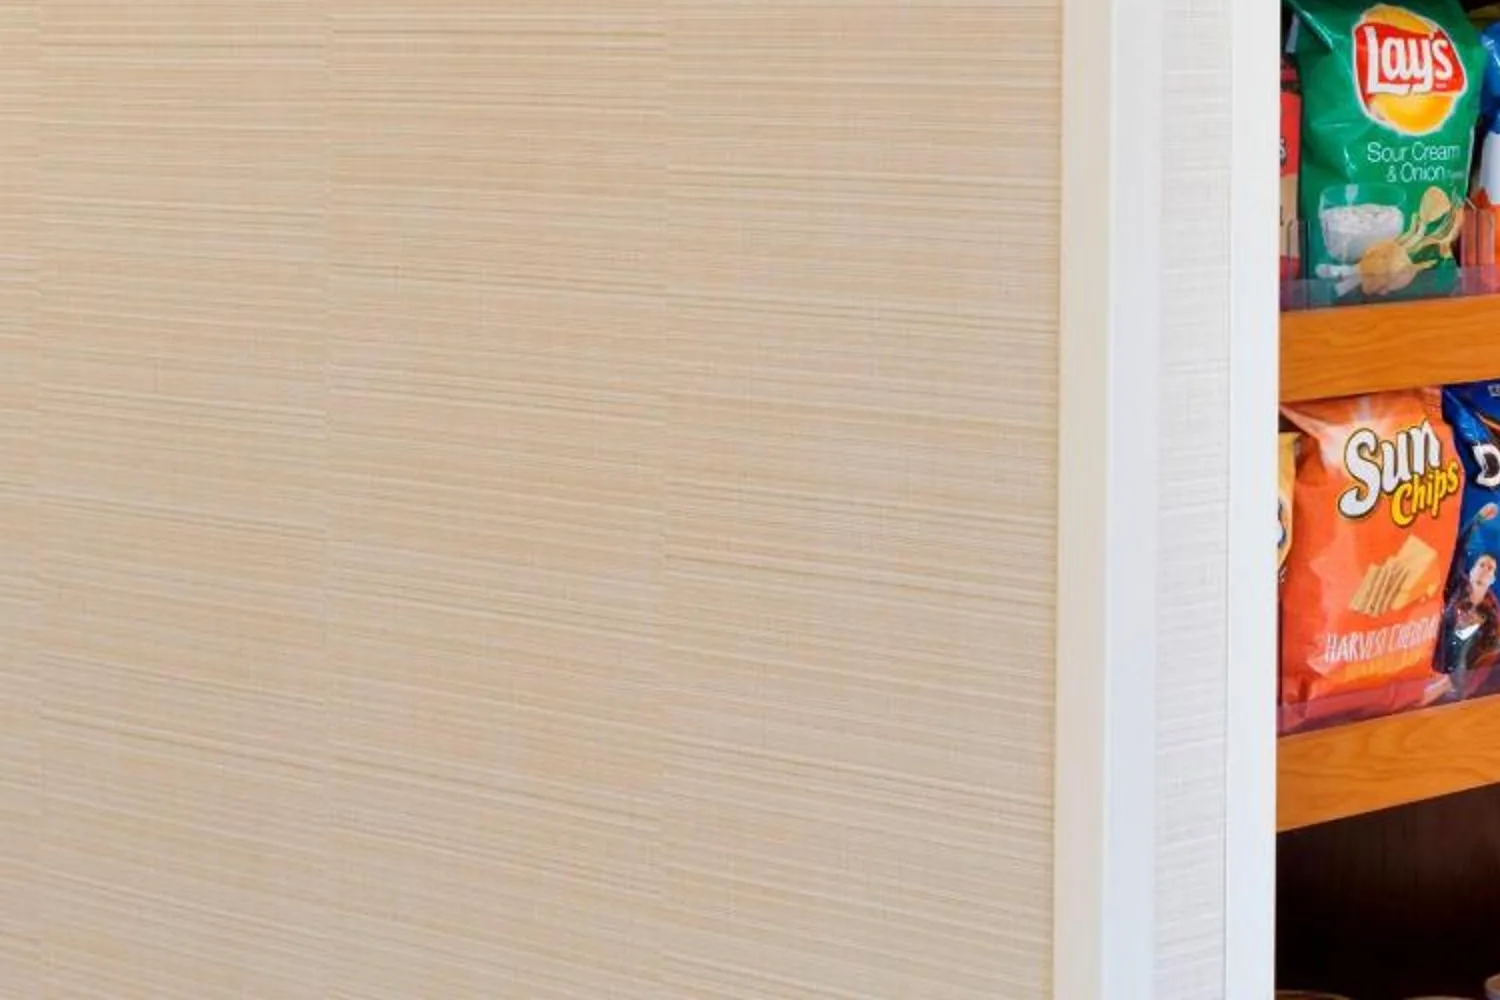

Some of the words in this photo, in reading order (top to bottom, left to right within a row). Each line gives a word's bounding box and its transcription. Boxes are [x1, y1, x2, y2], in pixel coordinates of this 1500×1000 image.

[1363, 25, 1455, 95] Lay's
[1367, 141, 1409, 163] Sour
[1411, 140, 1461, 162] Cream
[1400, 162, 1445, 183] Onion
[1339, 418, 1442, 517] Sun
[1391, 460, 1460, 527] Chips
